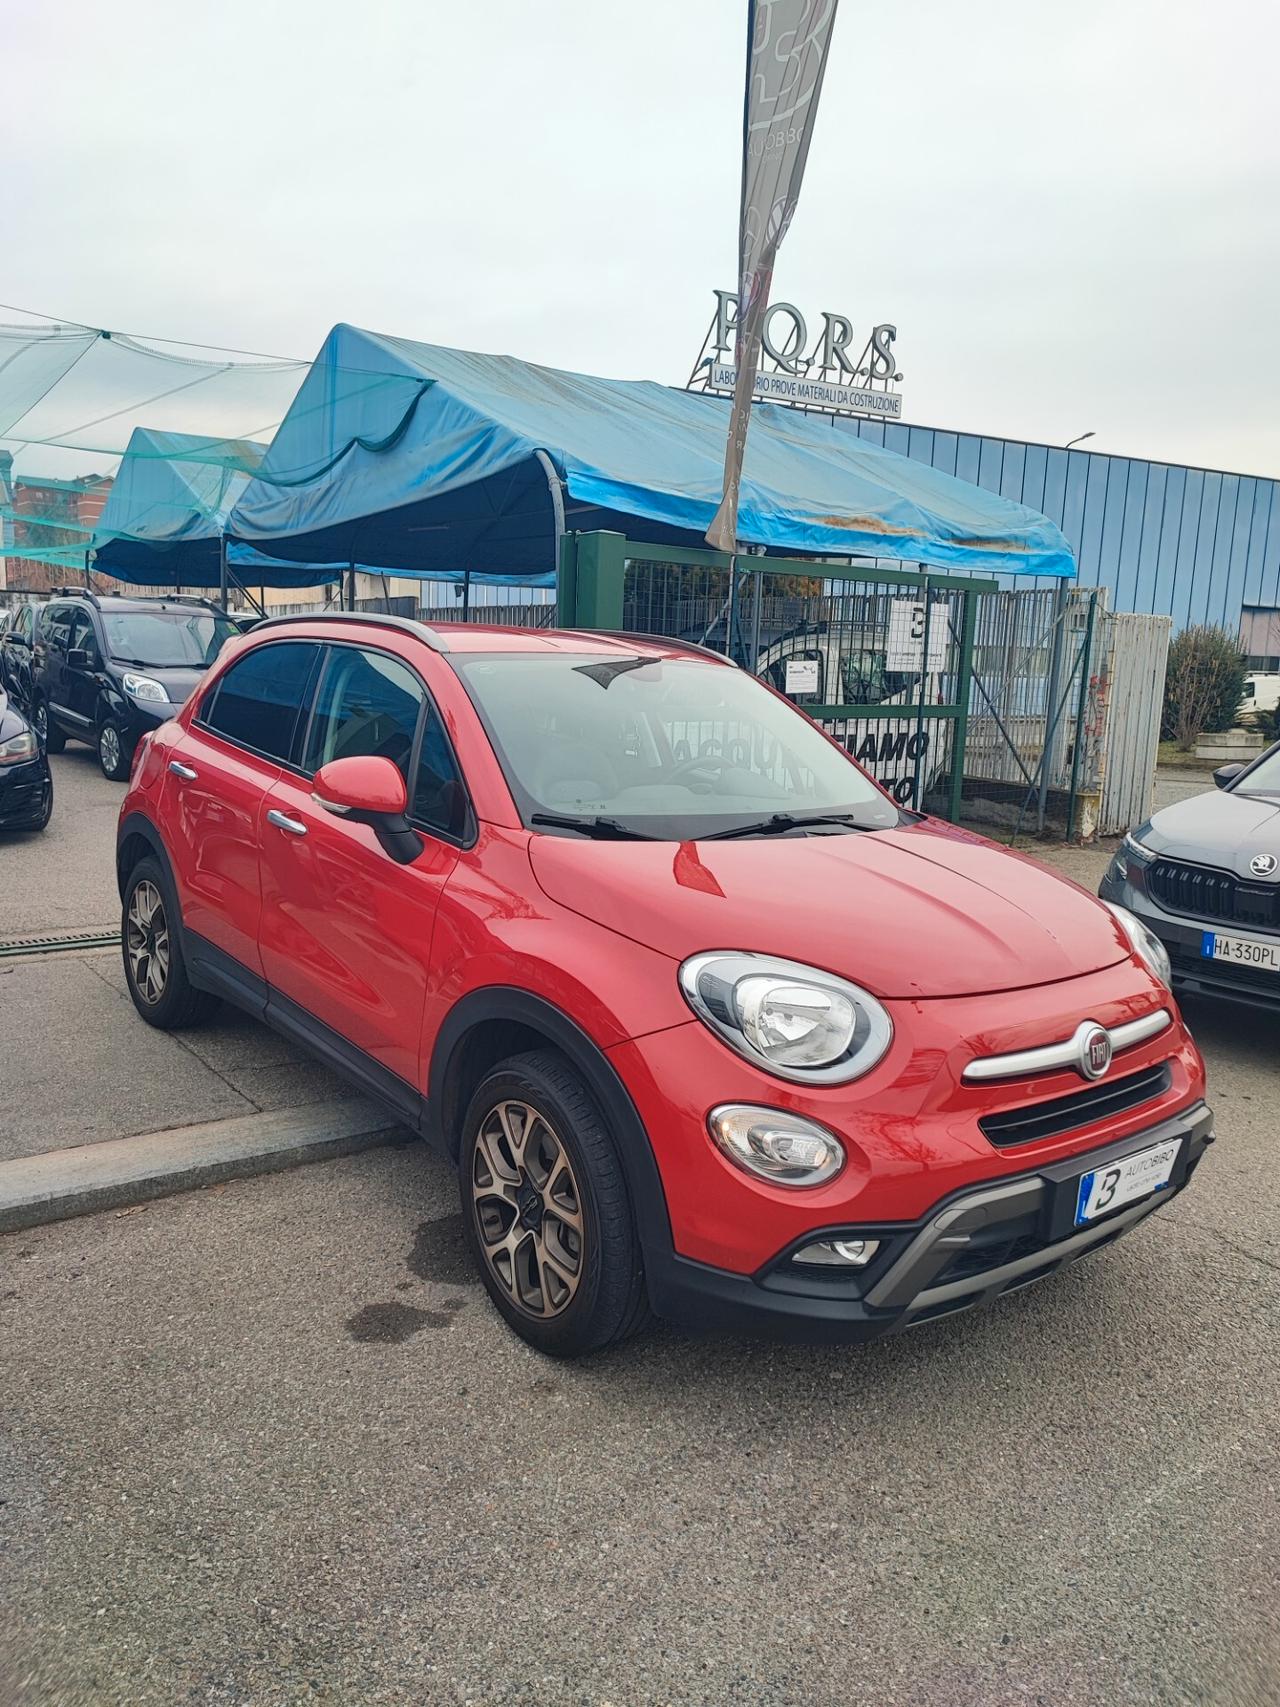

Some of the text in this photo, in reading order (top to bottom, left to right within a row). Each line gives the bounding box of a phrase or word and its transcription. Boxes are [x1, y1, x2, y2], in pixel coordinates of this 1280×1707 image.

[711, 289, 904, 381] PQ.R.S.
[714, 369, 899, 412] LABORIO PROVE MATERIALI DA COSTRUZIONE
